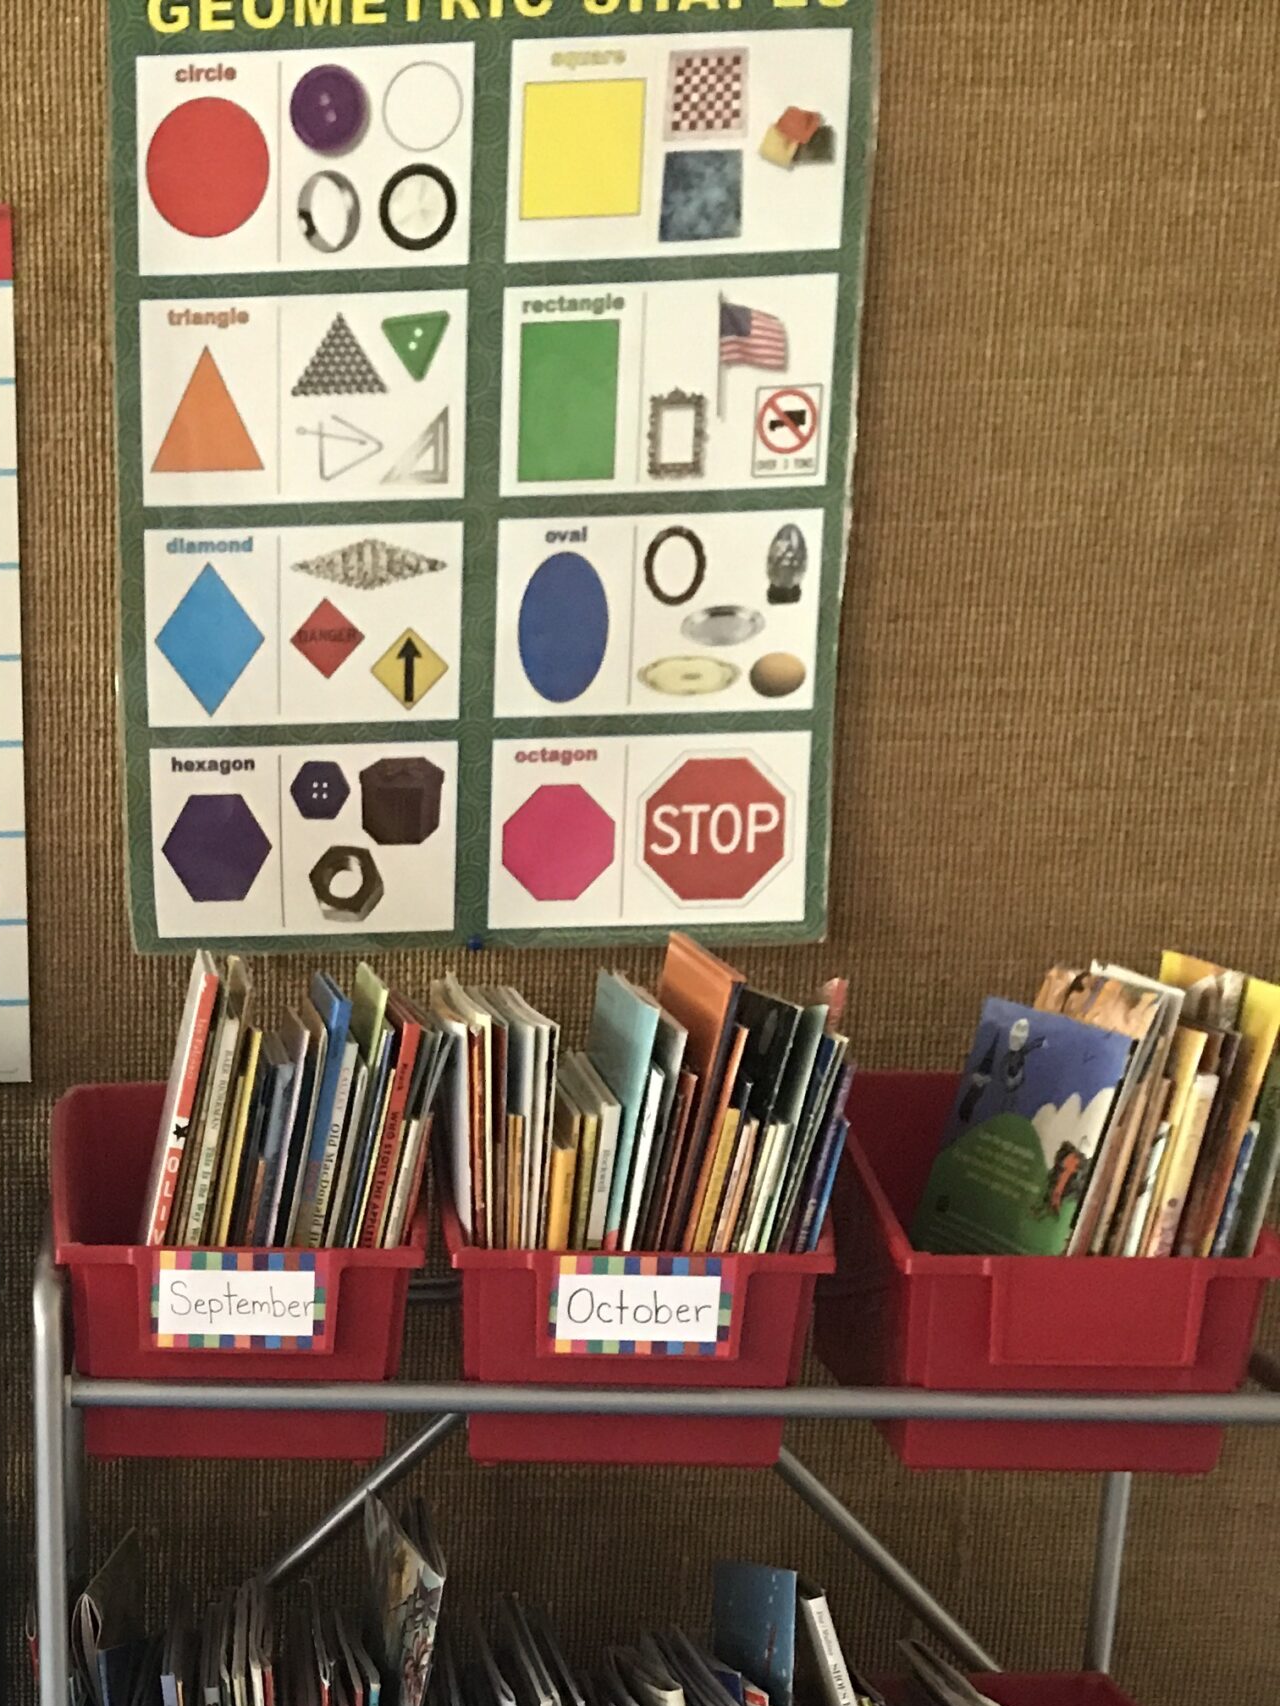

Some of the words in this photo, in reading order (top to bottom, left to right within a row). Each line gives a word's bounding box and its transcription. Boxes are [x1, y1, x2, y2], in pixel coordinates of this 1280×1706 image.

[175, 62, 237, 84] circle
[522, 292, 626, 315] rectangle
[167, 306, 250, 329] triangle
[166, 536, 253, 556] diamond
[545, 527, 588, 545] oval
[170, 755, 256, 777] hexagon
[514, 745, 599, 767] octagon
[649, 803, 780, 856] STOP
[170, 1281, 316, 1324] September
[567, 1287, 712, 1325] October
